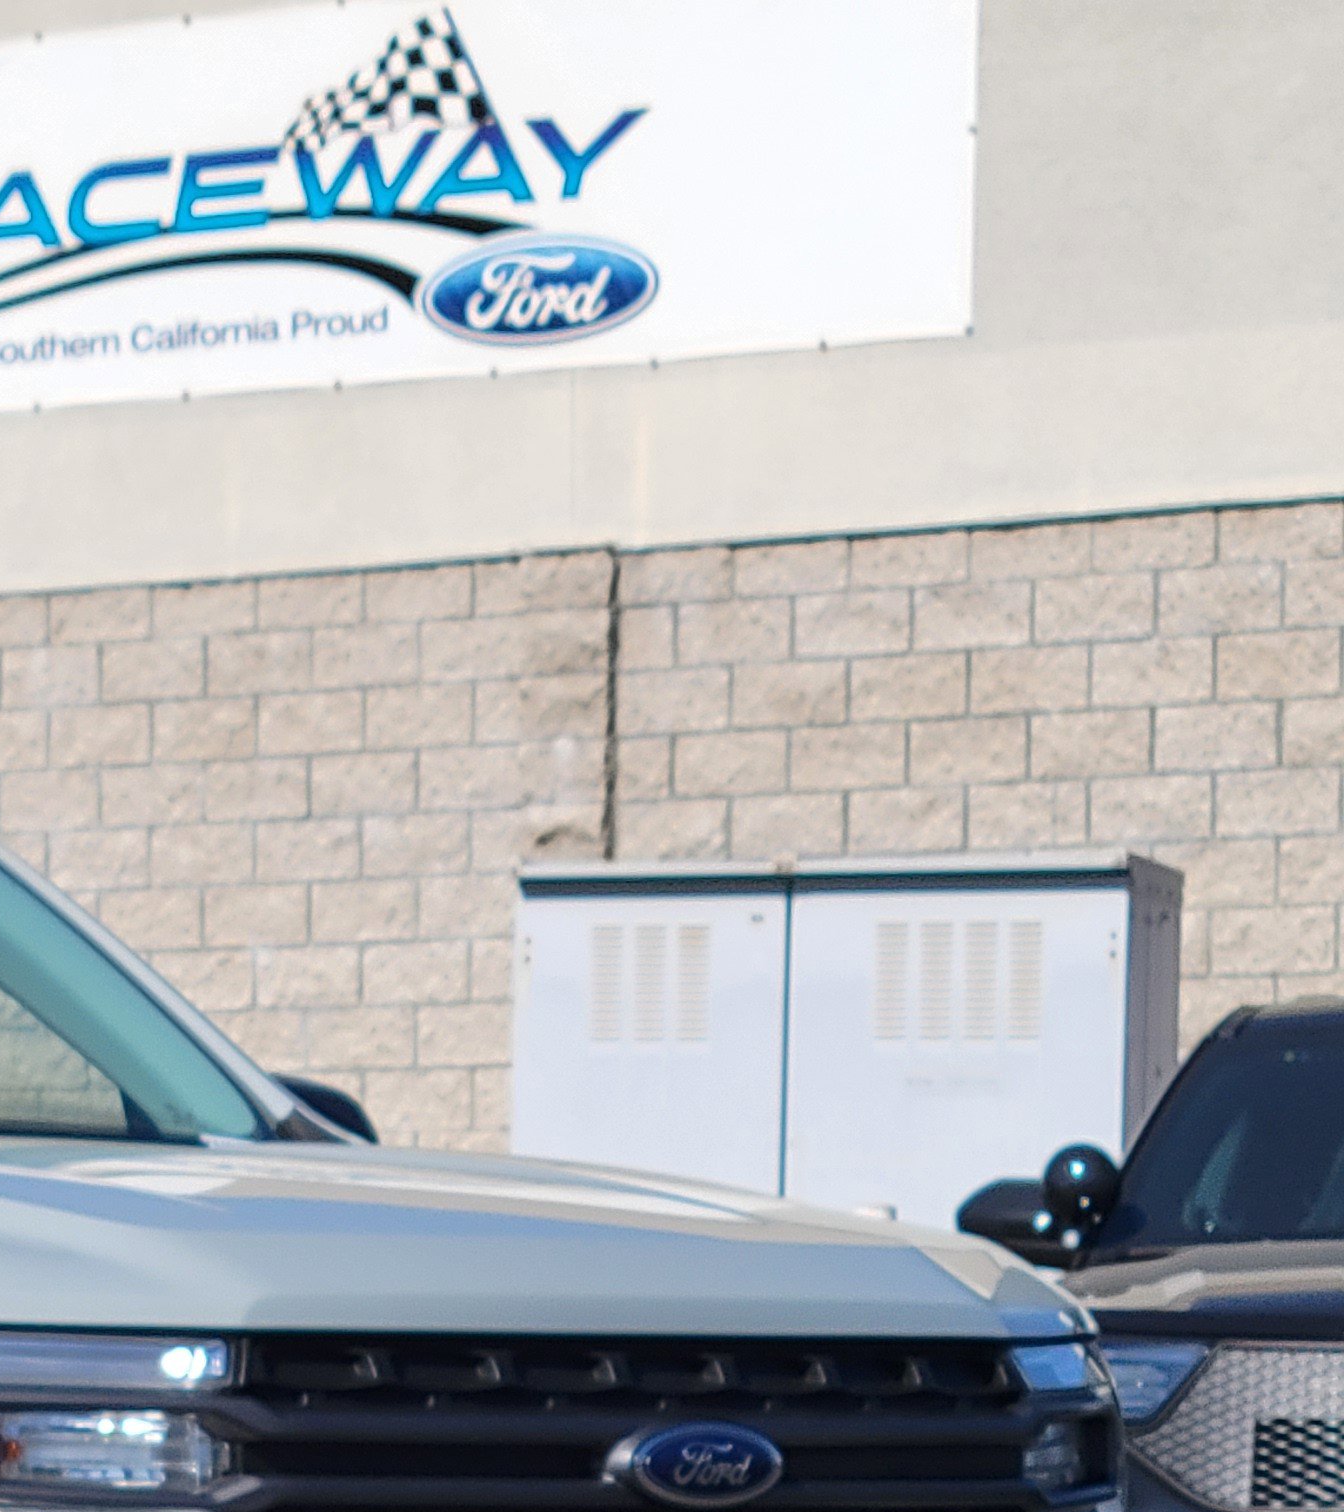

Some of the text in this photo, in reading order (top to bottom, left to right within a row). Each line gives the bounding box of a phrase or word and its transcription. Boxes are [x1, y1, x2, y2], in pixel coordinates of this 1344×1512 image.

[466, 252, 612, 329] Ford
[131, 318, 279, 353] California
[291, 305, 389, 340] Proud
[674, 1443, 753, 1485] Ford
